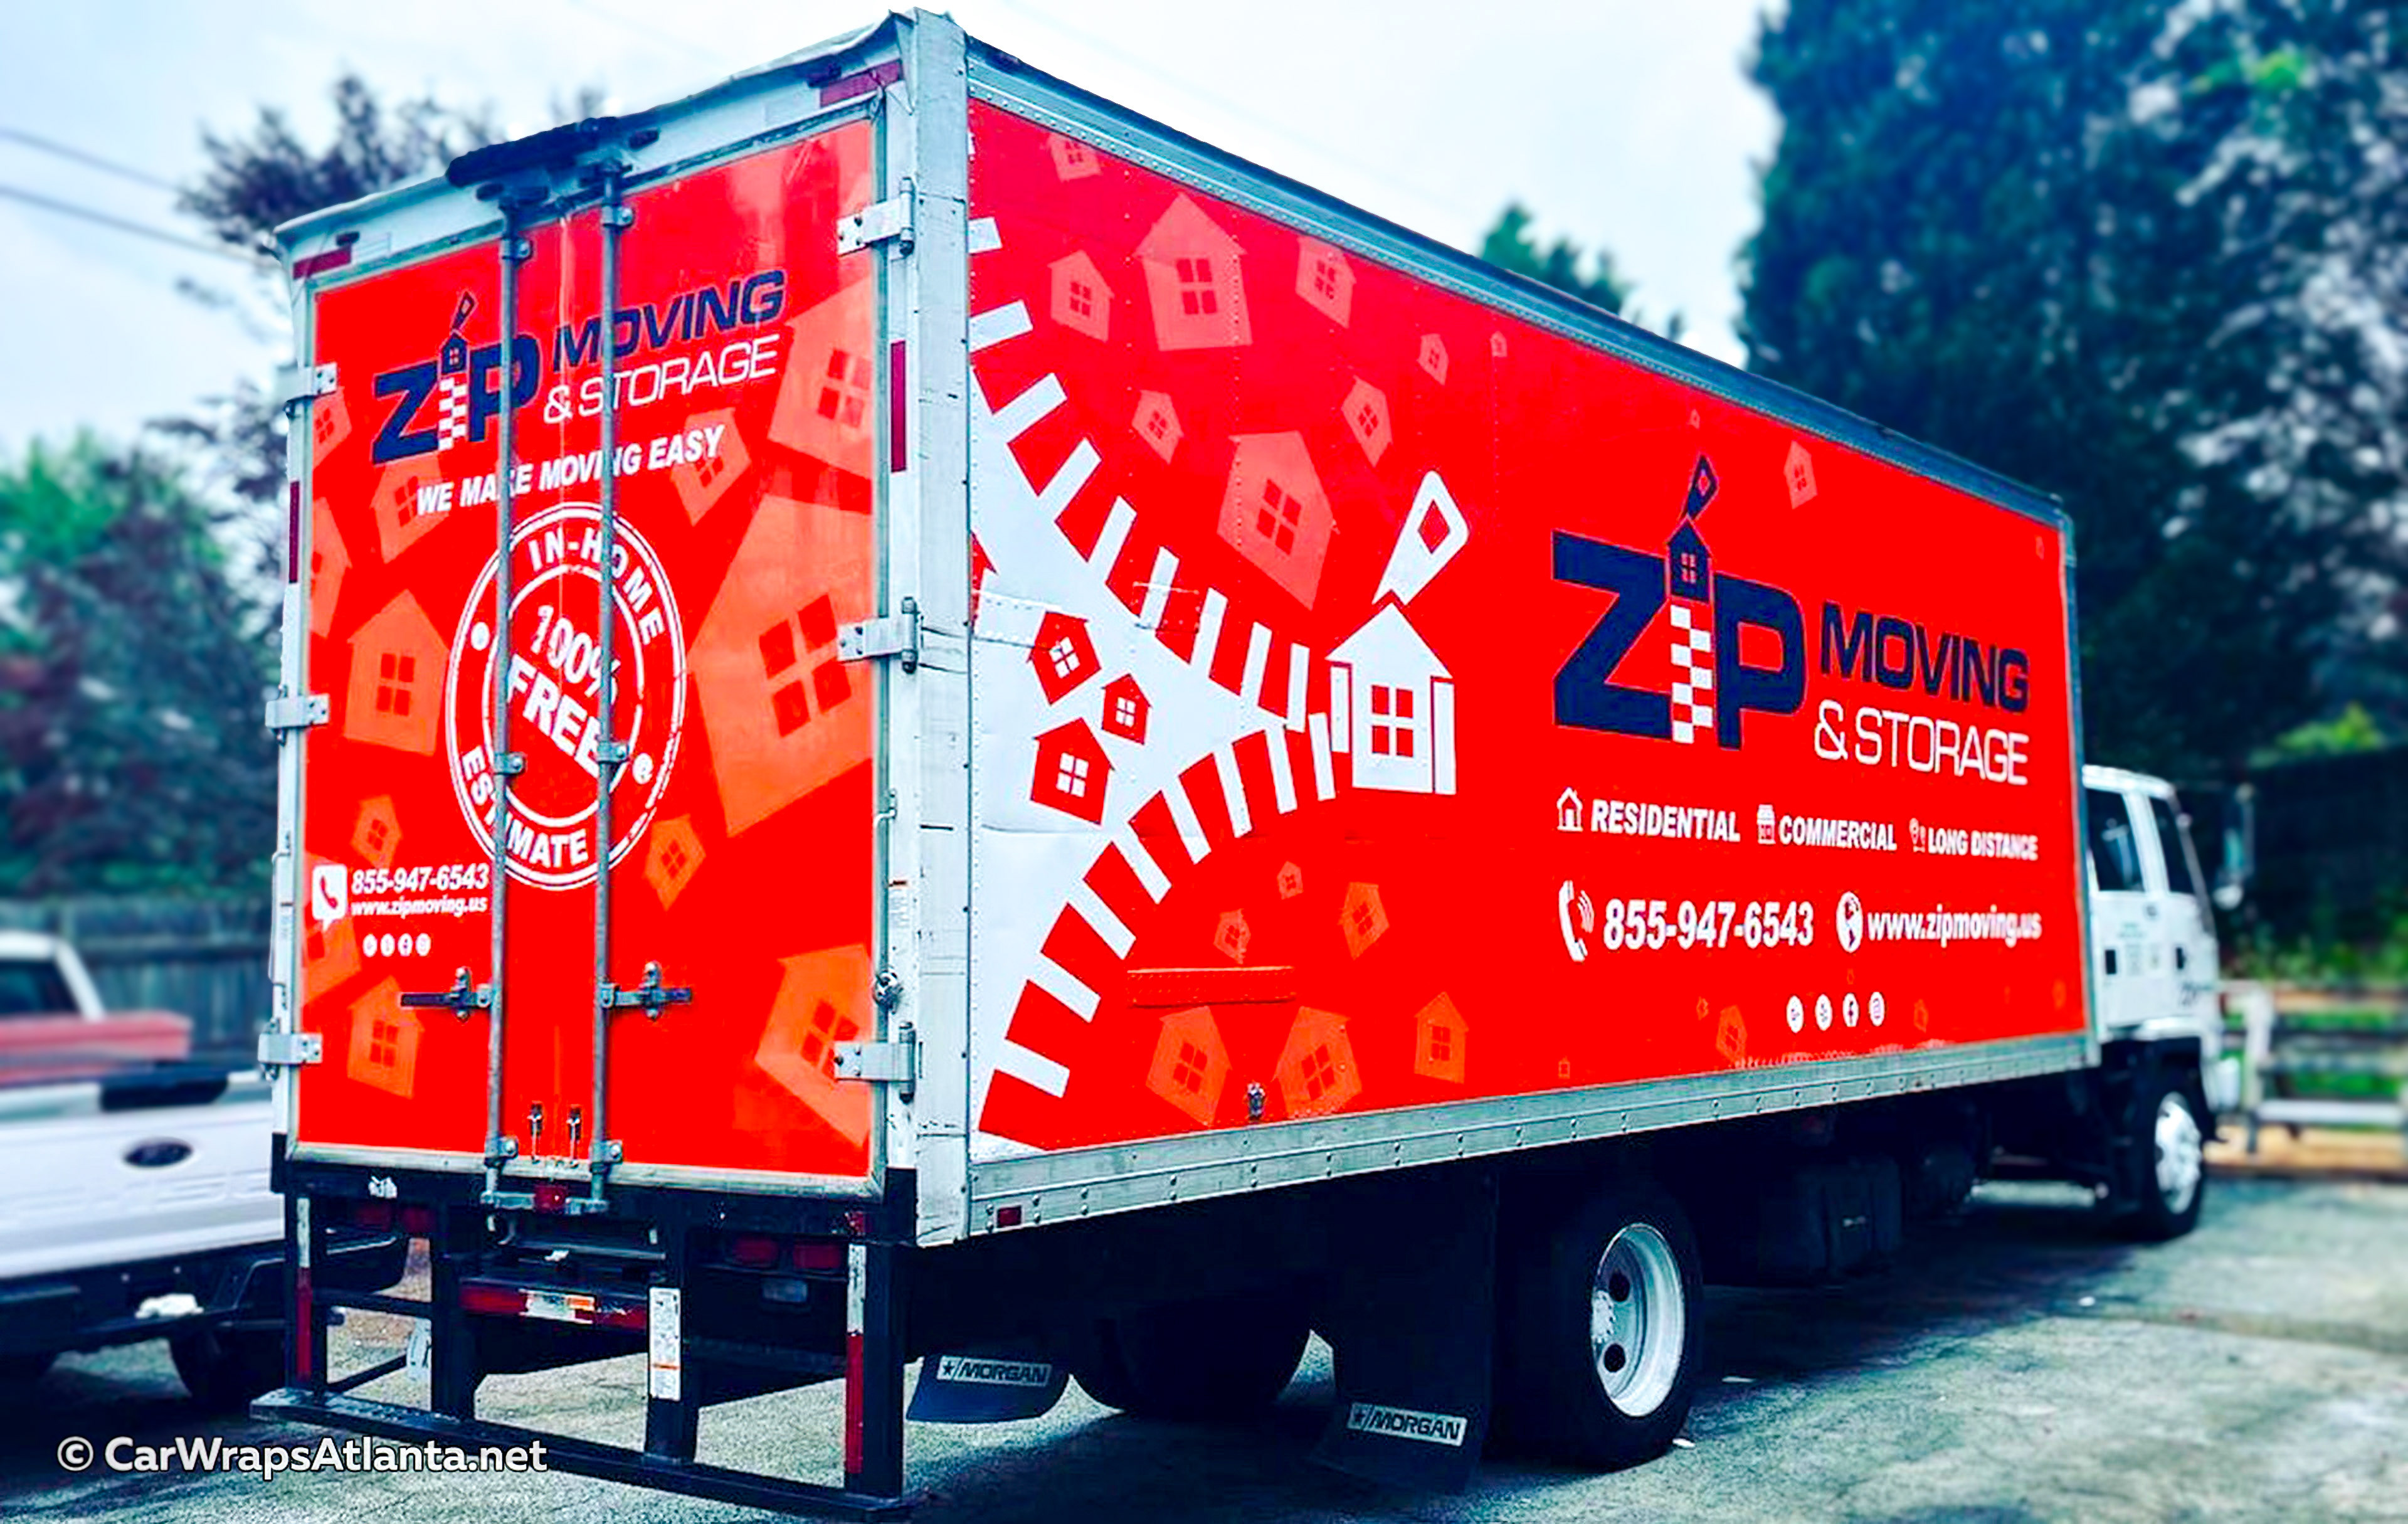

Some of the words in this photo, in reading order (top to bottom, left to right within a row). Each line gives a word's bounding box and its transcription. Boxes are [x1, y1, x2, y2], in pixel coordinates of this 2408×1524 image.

[553, 269, 785, 373] MOVING
[543, 384, 573, 425] &
[578, 333, 781, 417] STORAGE
[416, 482, 455, 515] WE
[539, 443, 642, 492] MOVING
[648, 424, 725, 470] EASY
[528, 526, 665, 645] IN-HOME
[531, 605, 621, 706] 100%
[1820, 601, 2030, 714] MOVING
[507, 653, 601, 778] FREE
[1814, 699, 1848, 761] &
[1854, 707, 2030, 785] STORAGE
[1591, 799, 1741, 842] RESIDENTIAL
[1779, 815, 1897, 851] COMMERCIAL
[1928, 827, 1968, 855] LONG
[1971, 830, 2039, 861] DISTANCE
[351, 862, 490, 895] 855-947-6543
[351, 894, 488, 919] www.zipmoving.us
[1603, 899, 1814, 950] 855-947-6543
[1867, 904, 2042, 948] www.zipmoving.us
[959, 1362, 1047, 1383] MORGAN
[1370, 1411, 1460, 1439] MORGAN
